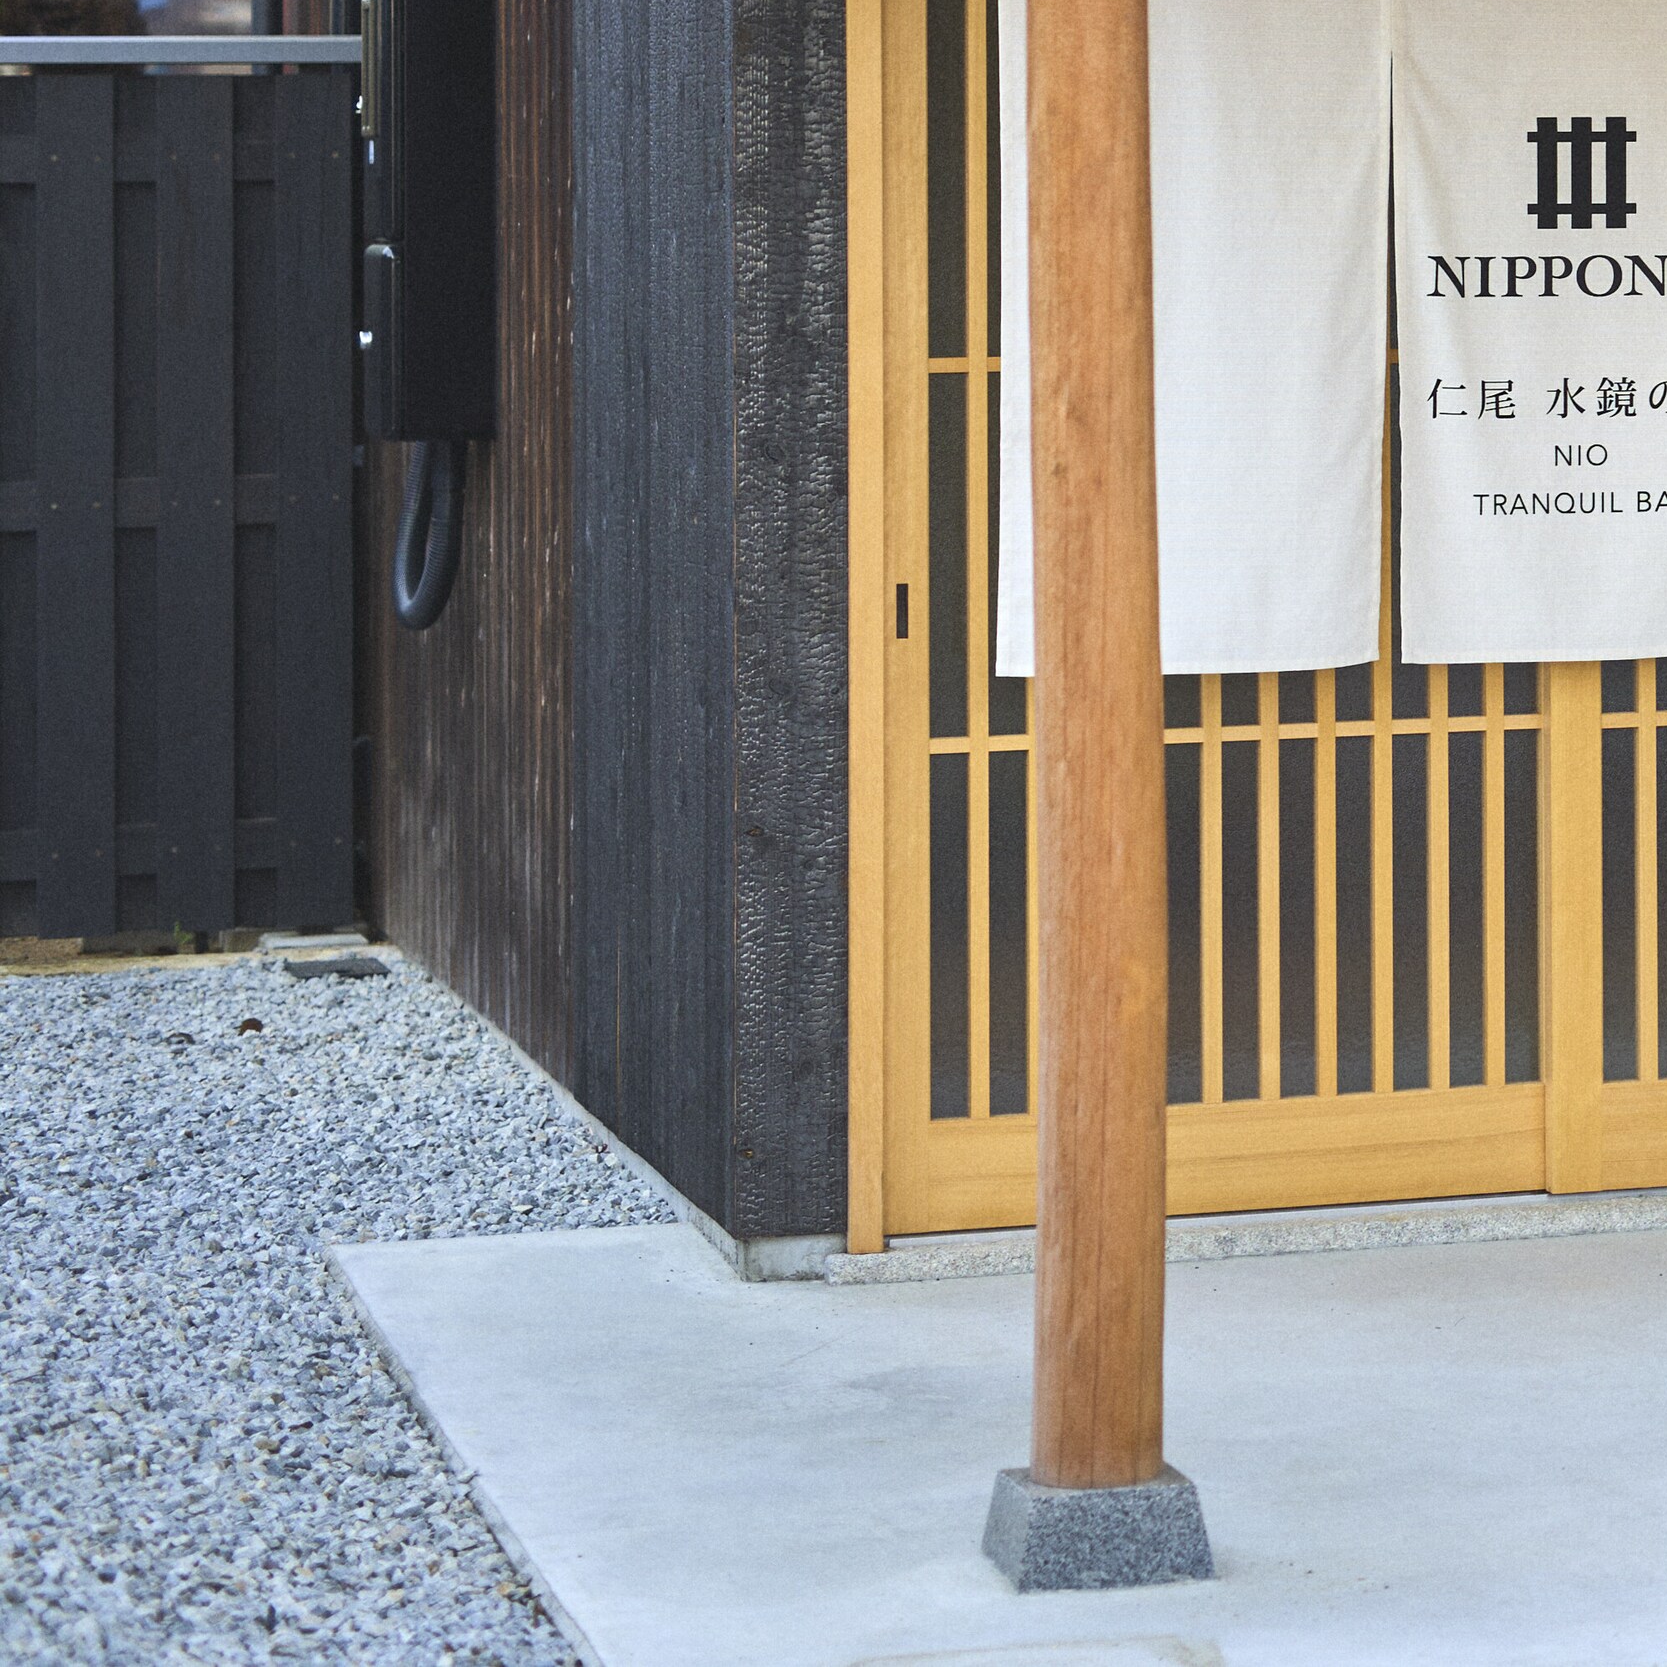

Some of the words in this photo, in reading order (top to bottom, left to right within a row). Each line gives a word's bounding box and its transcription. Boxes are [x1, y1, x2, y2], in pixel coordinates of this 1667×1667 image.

[1427, 378, 1516, 420] 仁尾
[1554, 443, 1608, 467] NIO
[1472, 491, 1624, 516] TRANQUIL
